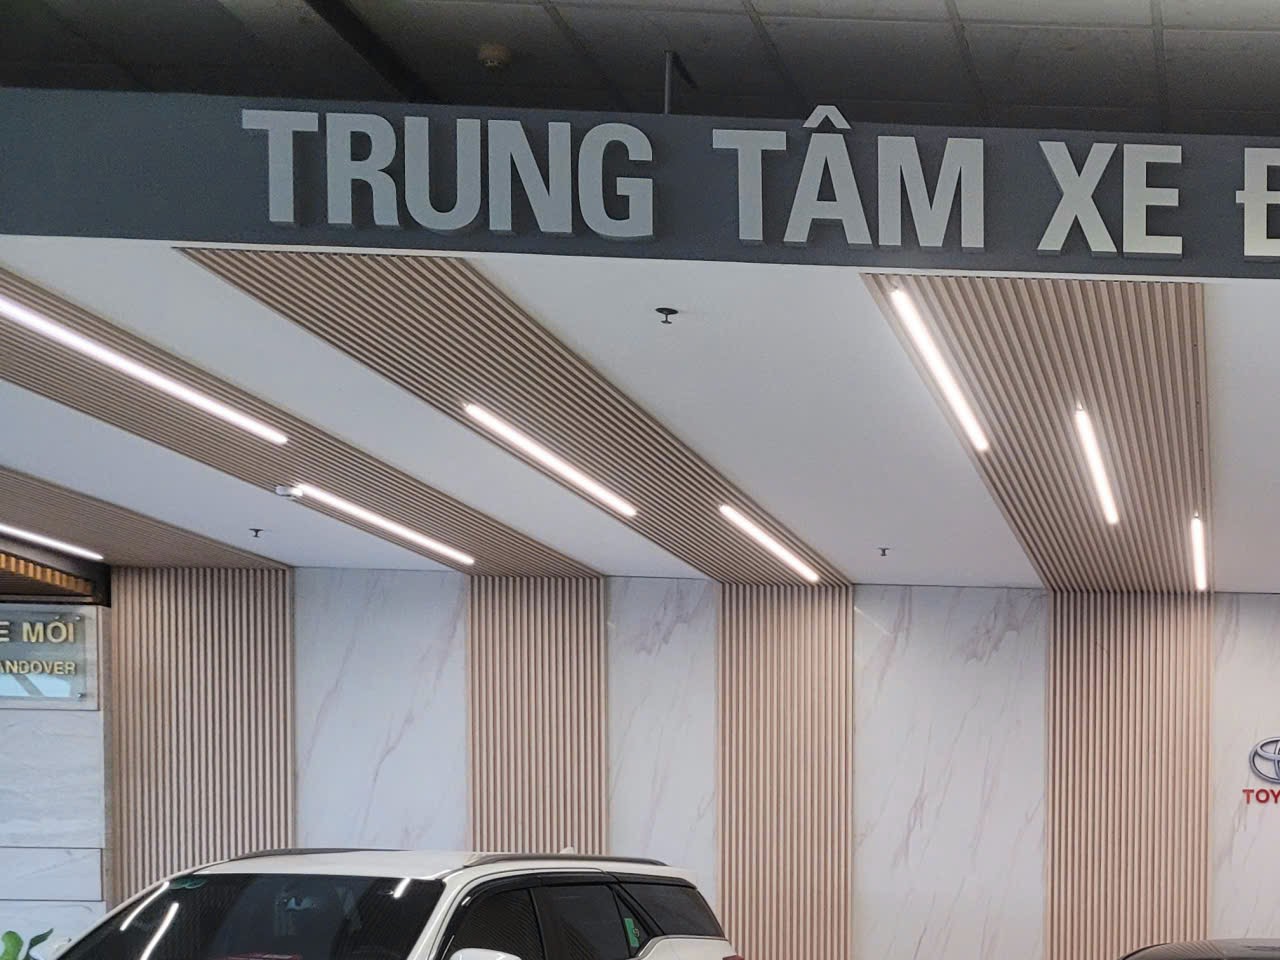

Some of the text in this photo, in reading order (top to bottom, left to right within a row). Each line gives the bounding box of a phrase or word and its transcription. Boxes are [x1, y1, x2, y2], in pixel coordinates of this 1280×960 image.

[241, 108, 655, 241] TRUNG
[711, 104, 986, 249] TÂM
[1036, 140, 1184, 259] XE
